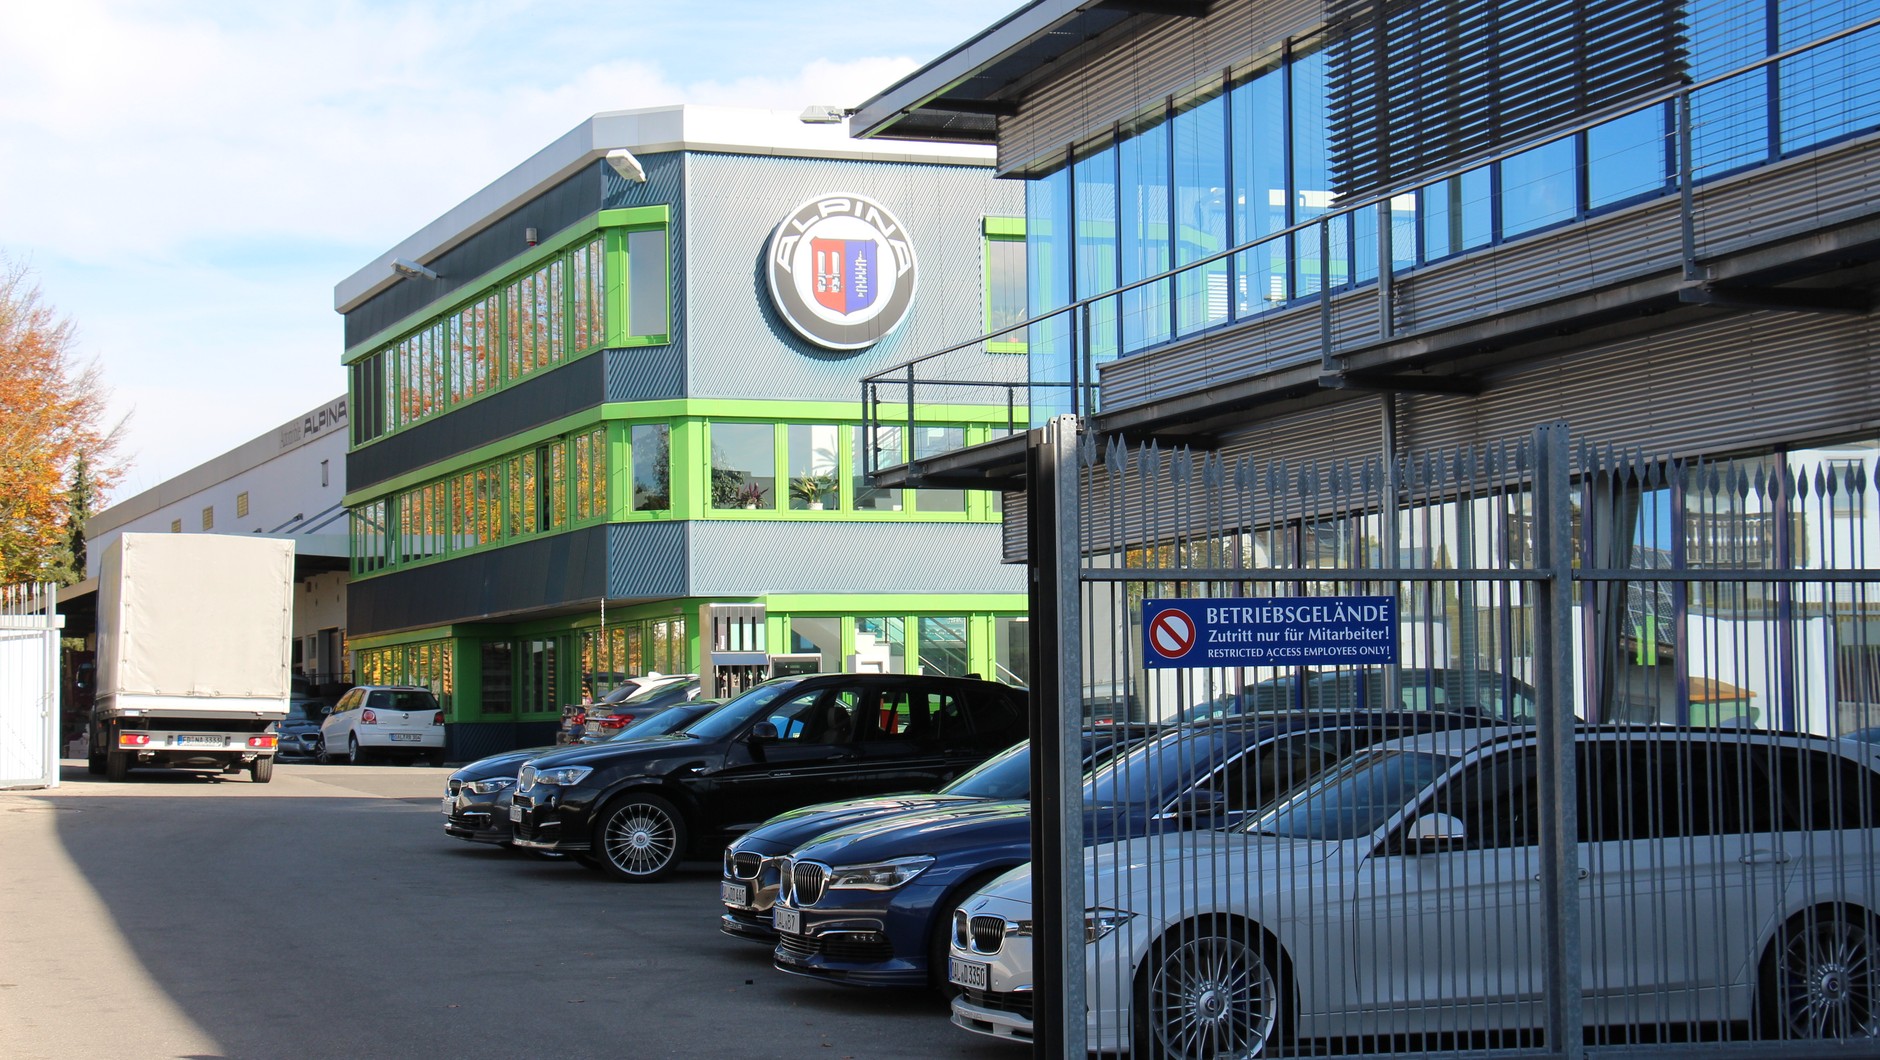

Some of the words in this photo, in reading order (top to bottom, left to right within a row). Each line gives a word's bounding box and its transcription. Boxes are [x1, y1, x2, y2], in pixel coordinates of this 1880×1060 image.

[776, 198, 912, 279] ALPINA
[303, 400, 348, 438] ALPINA
[1206, 602, 1389, 624] BETRIEBSGELÄNDE
[1208, 629, 1252, 643] Zutritt
[1257, 631, 1280, 642] nur
[1284, 628, 1304, 642] für
[1308, 626, 1390, 641] Mitarbeiter!
[1208, 648, 1264, 658] RESTRICTED
[1266, 647, 1302, 657] ACCESS
[1304, 646, 1357, 656] EMPLOYEES
[1359, 646, 1390, 656] ONLY!
